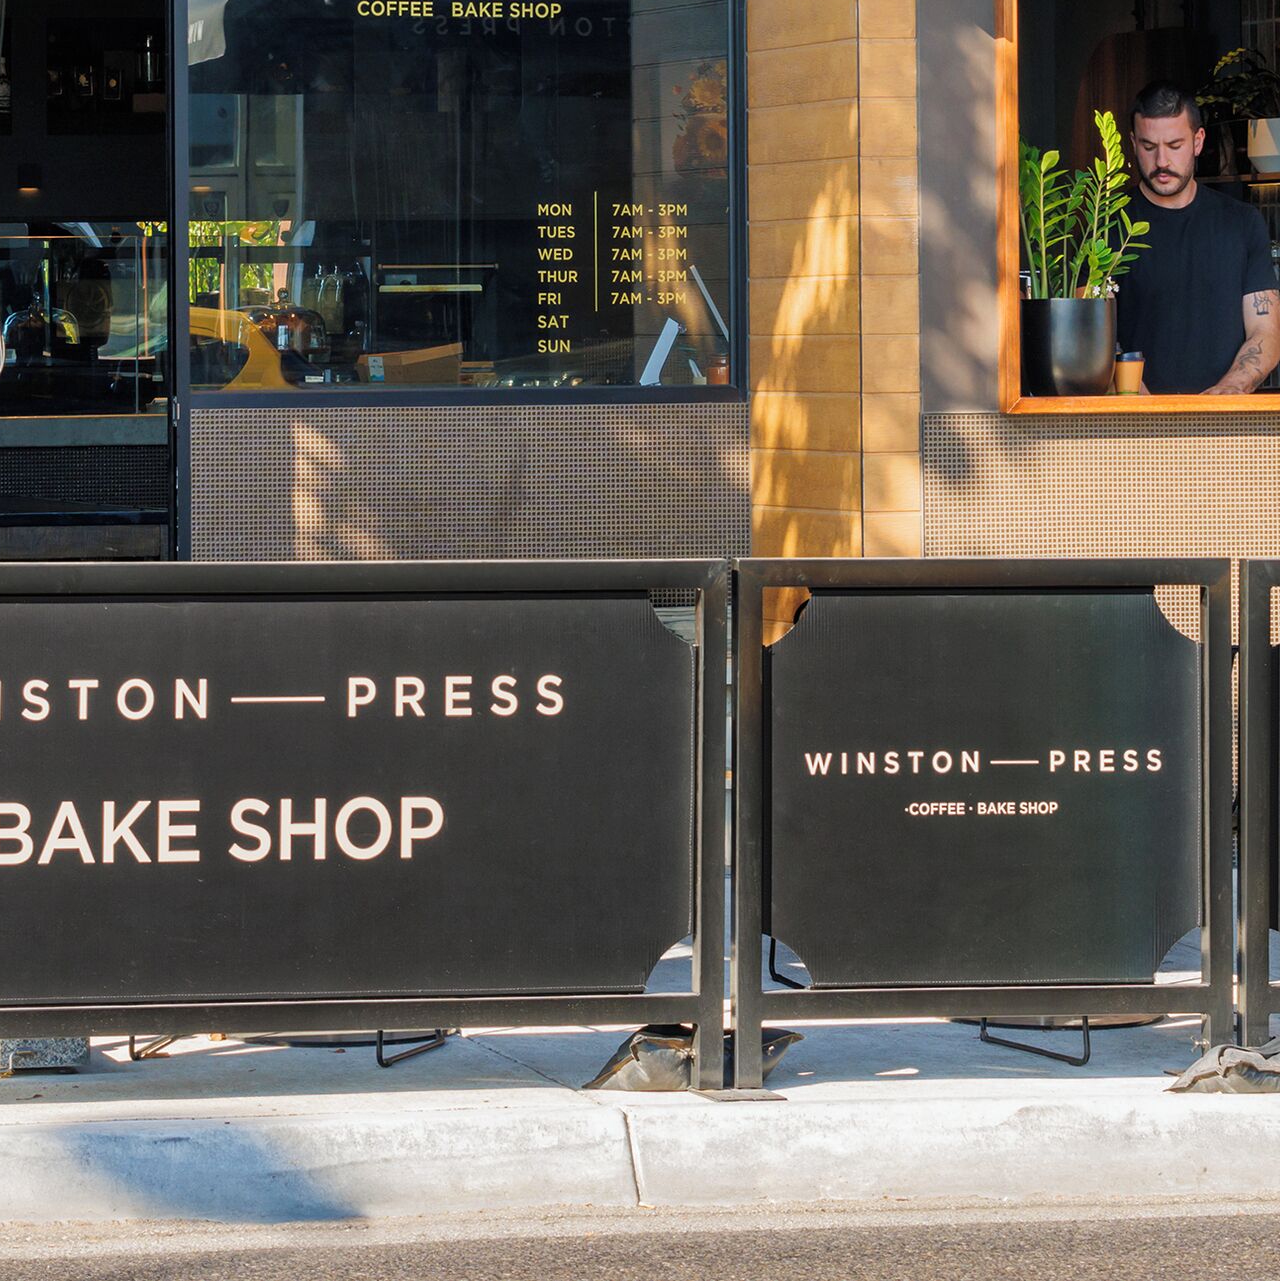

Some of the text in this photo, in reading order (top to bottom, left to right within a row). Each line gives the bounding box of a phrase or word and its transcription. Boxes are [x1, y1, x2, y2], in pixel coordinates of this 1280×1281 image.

[357, 0, 562, 19] COFFEE BAKE SHOP
[537, 203, 572, 217] MON
[612, 204, 643, 217] 7AM
[658, 204, 688, 217] 3PM
[537, 226, 576, 239] TUES
[612, 226, 643, 239] 7AM
[658, 226, 688, 239] 3PM
[537, 248, 574, 261] WED
[611, 248, 642, 261] 7AM
[657, 248, 687, 261] 3PM
[537, 270, 578, 283] THUR
[611, 270, 642, 283] 7AM
[657, 270, 687, 283] 3PM
[537, 292, 562, 305] FRI
[611, 292, 642, 305] 7AM
[657, 292, 687, 305] 3PM
[537, 315, 569, 329] SAT
[537, 339, 571, 353] SUN
[347, 674, 565, 718] PRESS
[804, 748, 1163, 776] WINSTON PRESS
[977, 801, 1016, 815] BAKE
[1019, 801, 1059, 815] SHOP
[228, 796, 444, 862] SHOP
